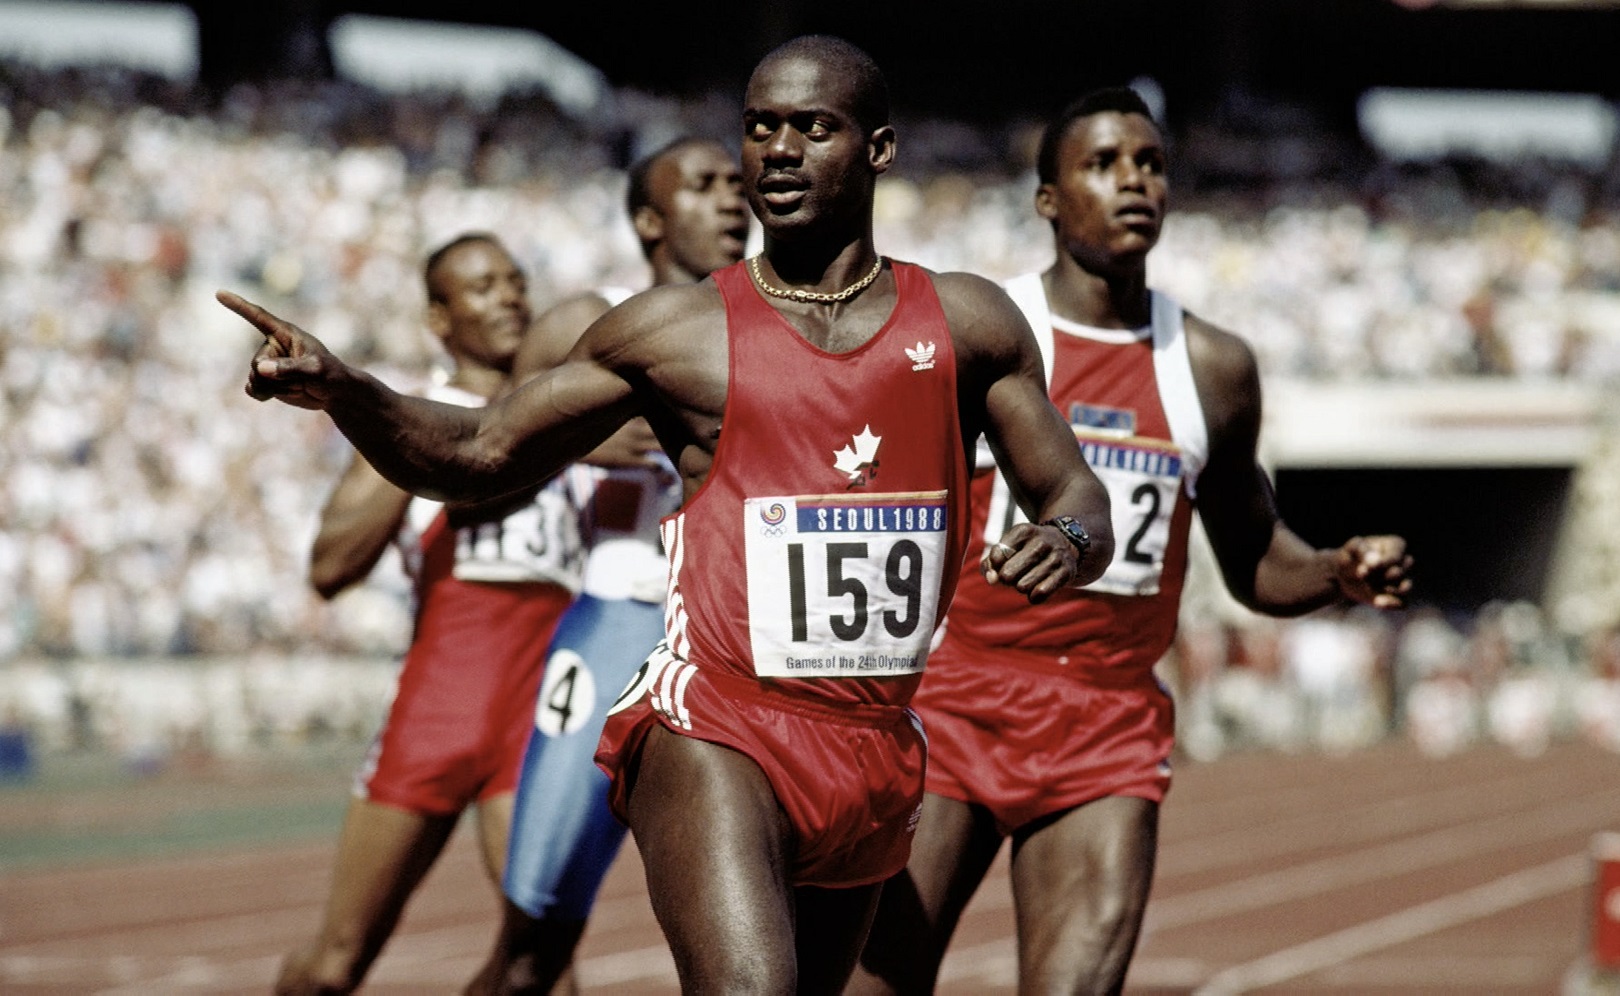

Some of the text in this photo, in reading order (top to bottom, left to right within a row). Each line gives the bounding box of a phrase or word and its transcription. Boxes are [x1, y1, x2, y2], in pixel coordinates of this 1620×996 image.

[787, 539, 923, 642] 159
[786, 656, 823, 670] Games
[825, 655, 836, 669] of
[839, 656, 855, 669] the
[549, 665, 578, 734] 4
